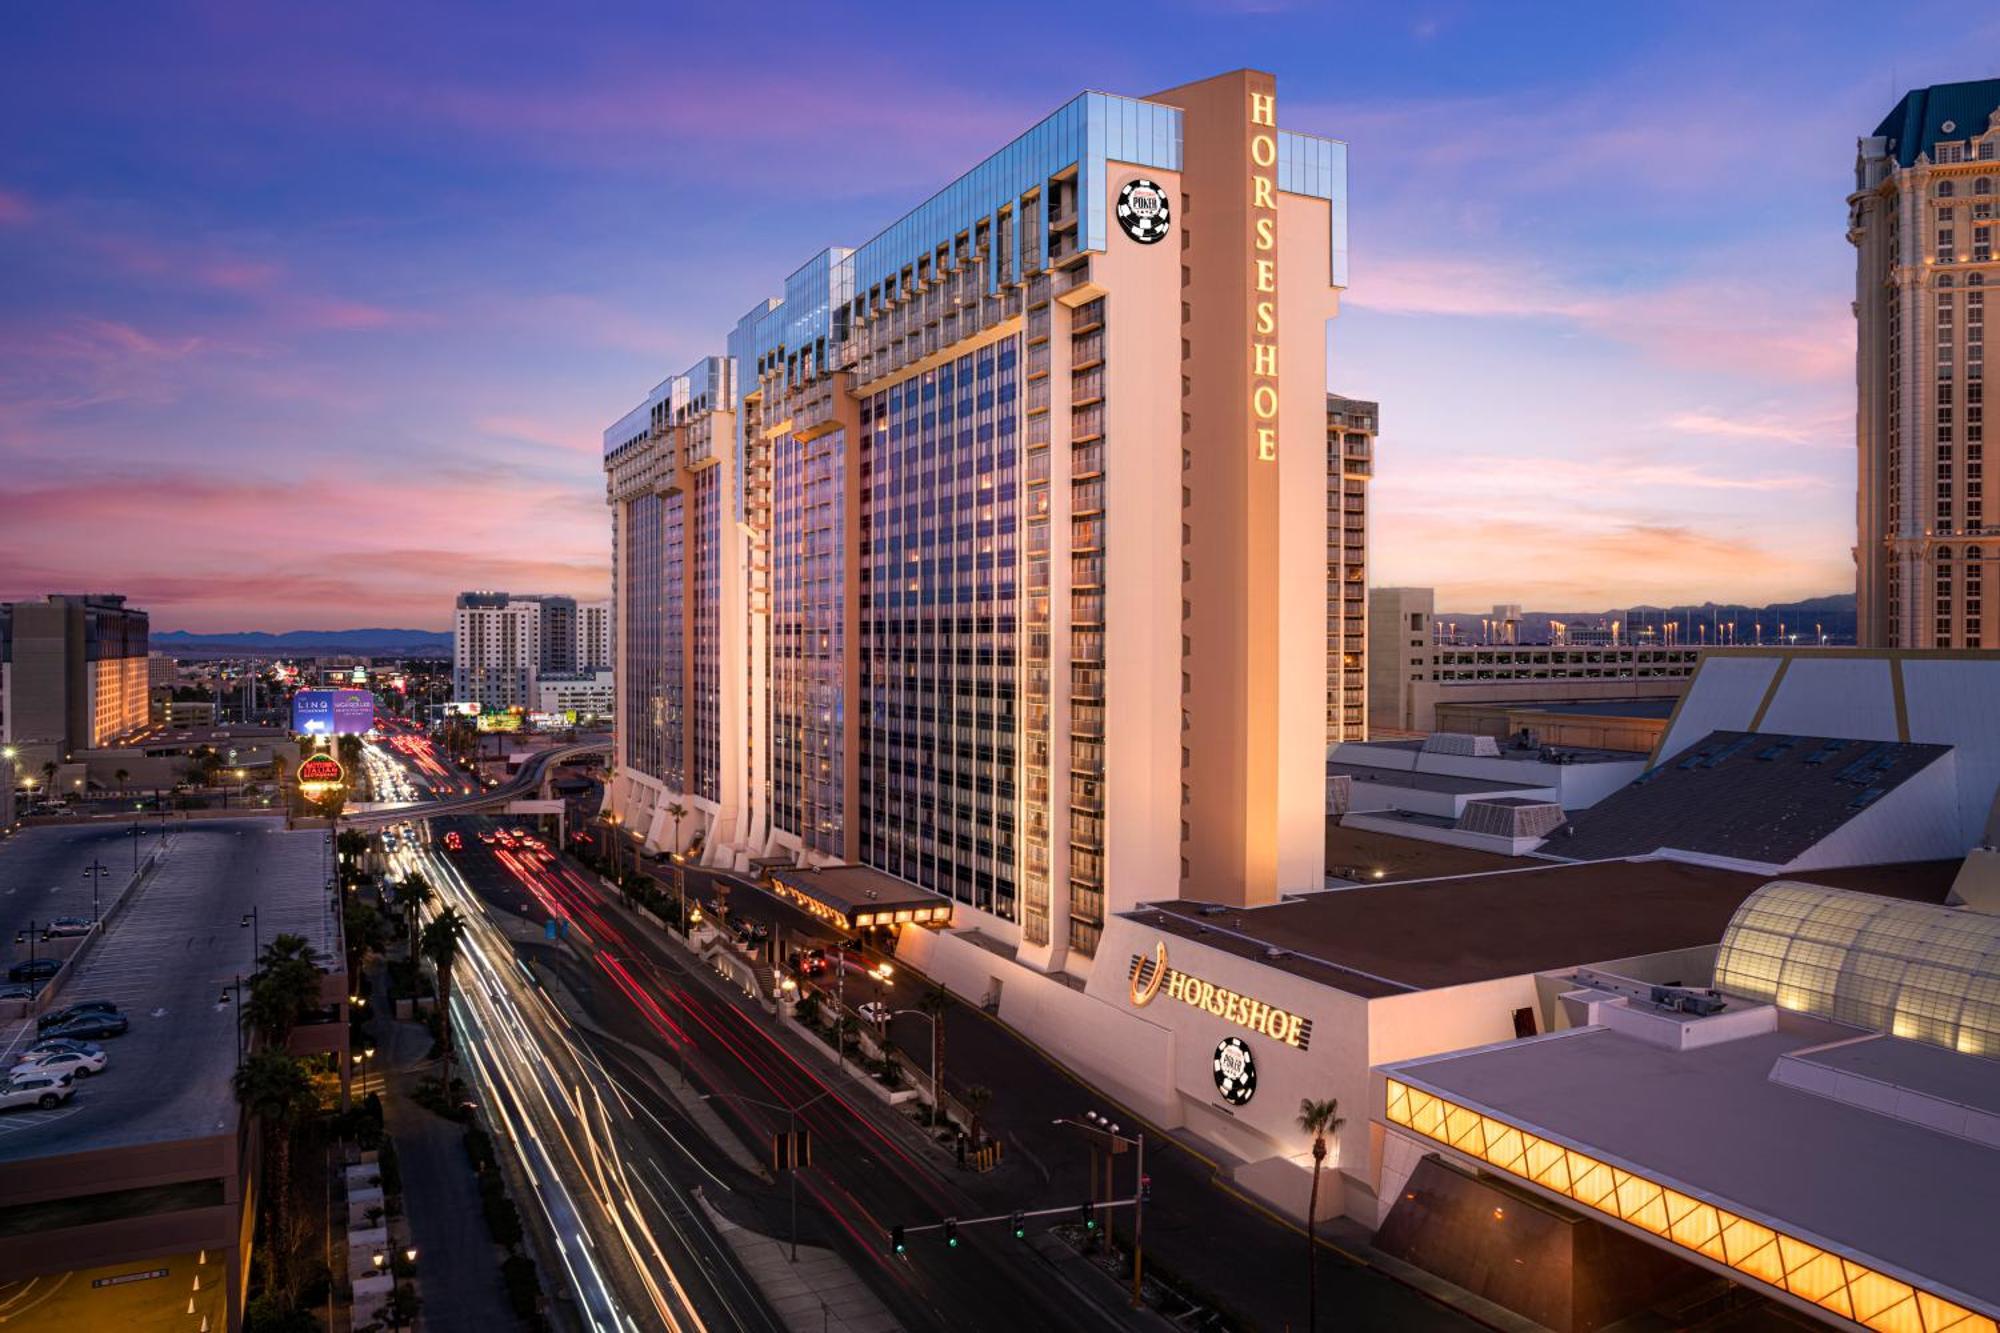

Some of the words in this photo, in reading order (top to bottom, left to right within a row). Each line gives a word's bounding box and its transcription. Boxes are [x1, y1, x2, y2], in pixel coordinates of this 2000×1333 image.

[1132, 196, 1157, 210] POKER
[1250, 92, 1278, 462] HORSESHOE
[298, 701, 328, 709] LINQ
[1167, 970, 1303, 1047] HORSESHOE
